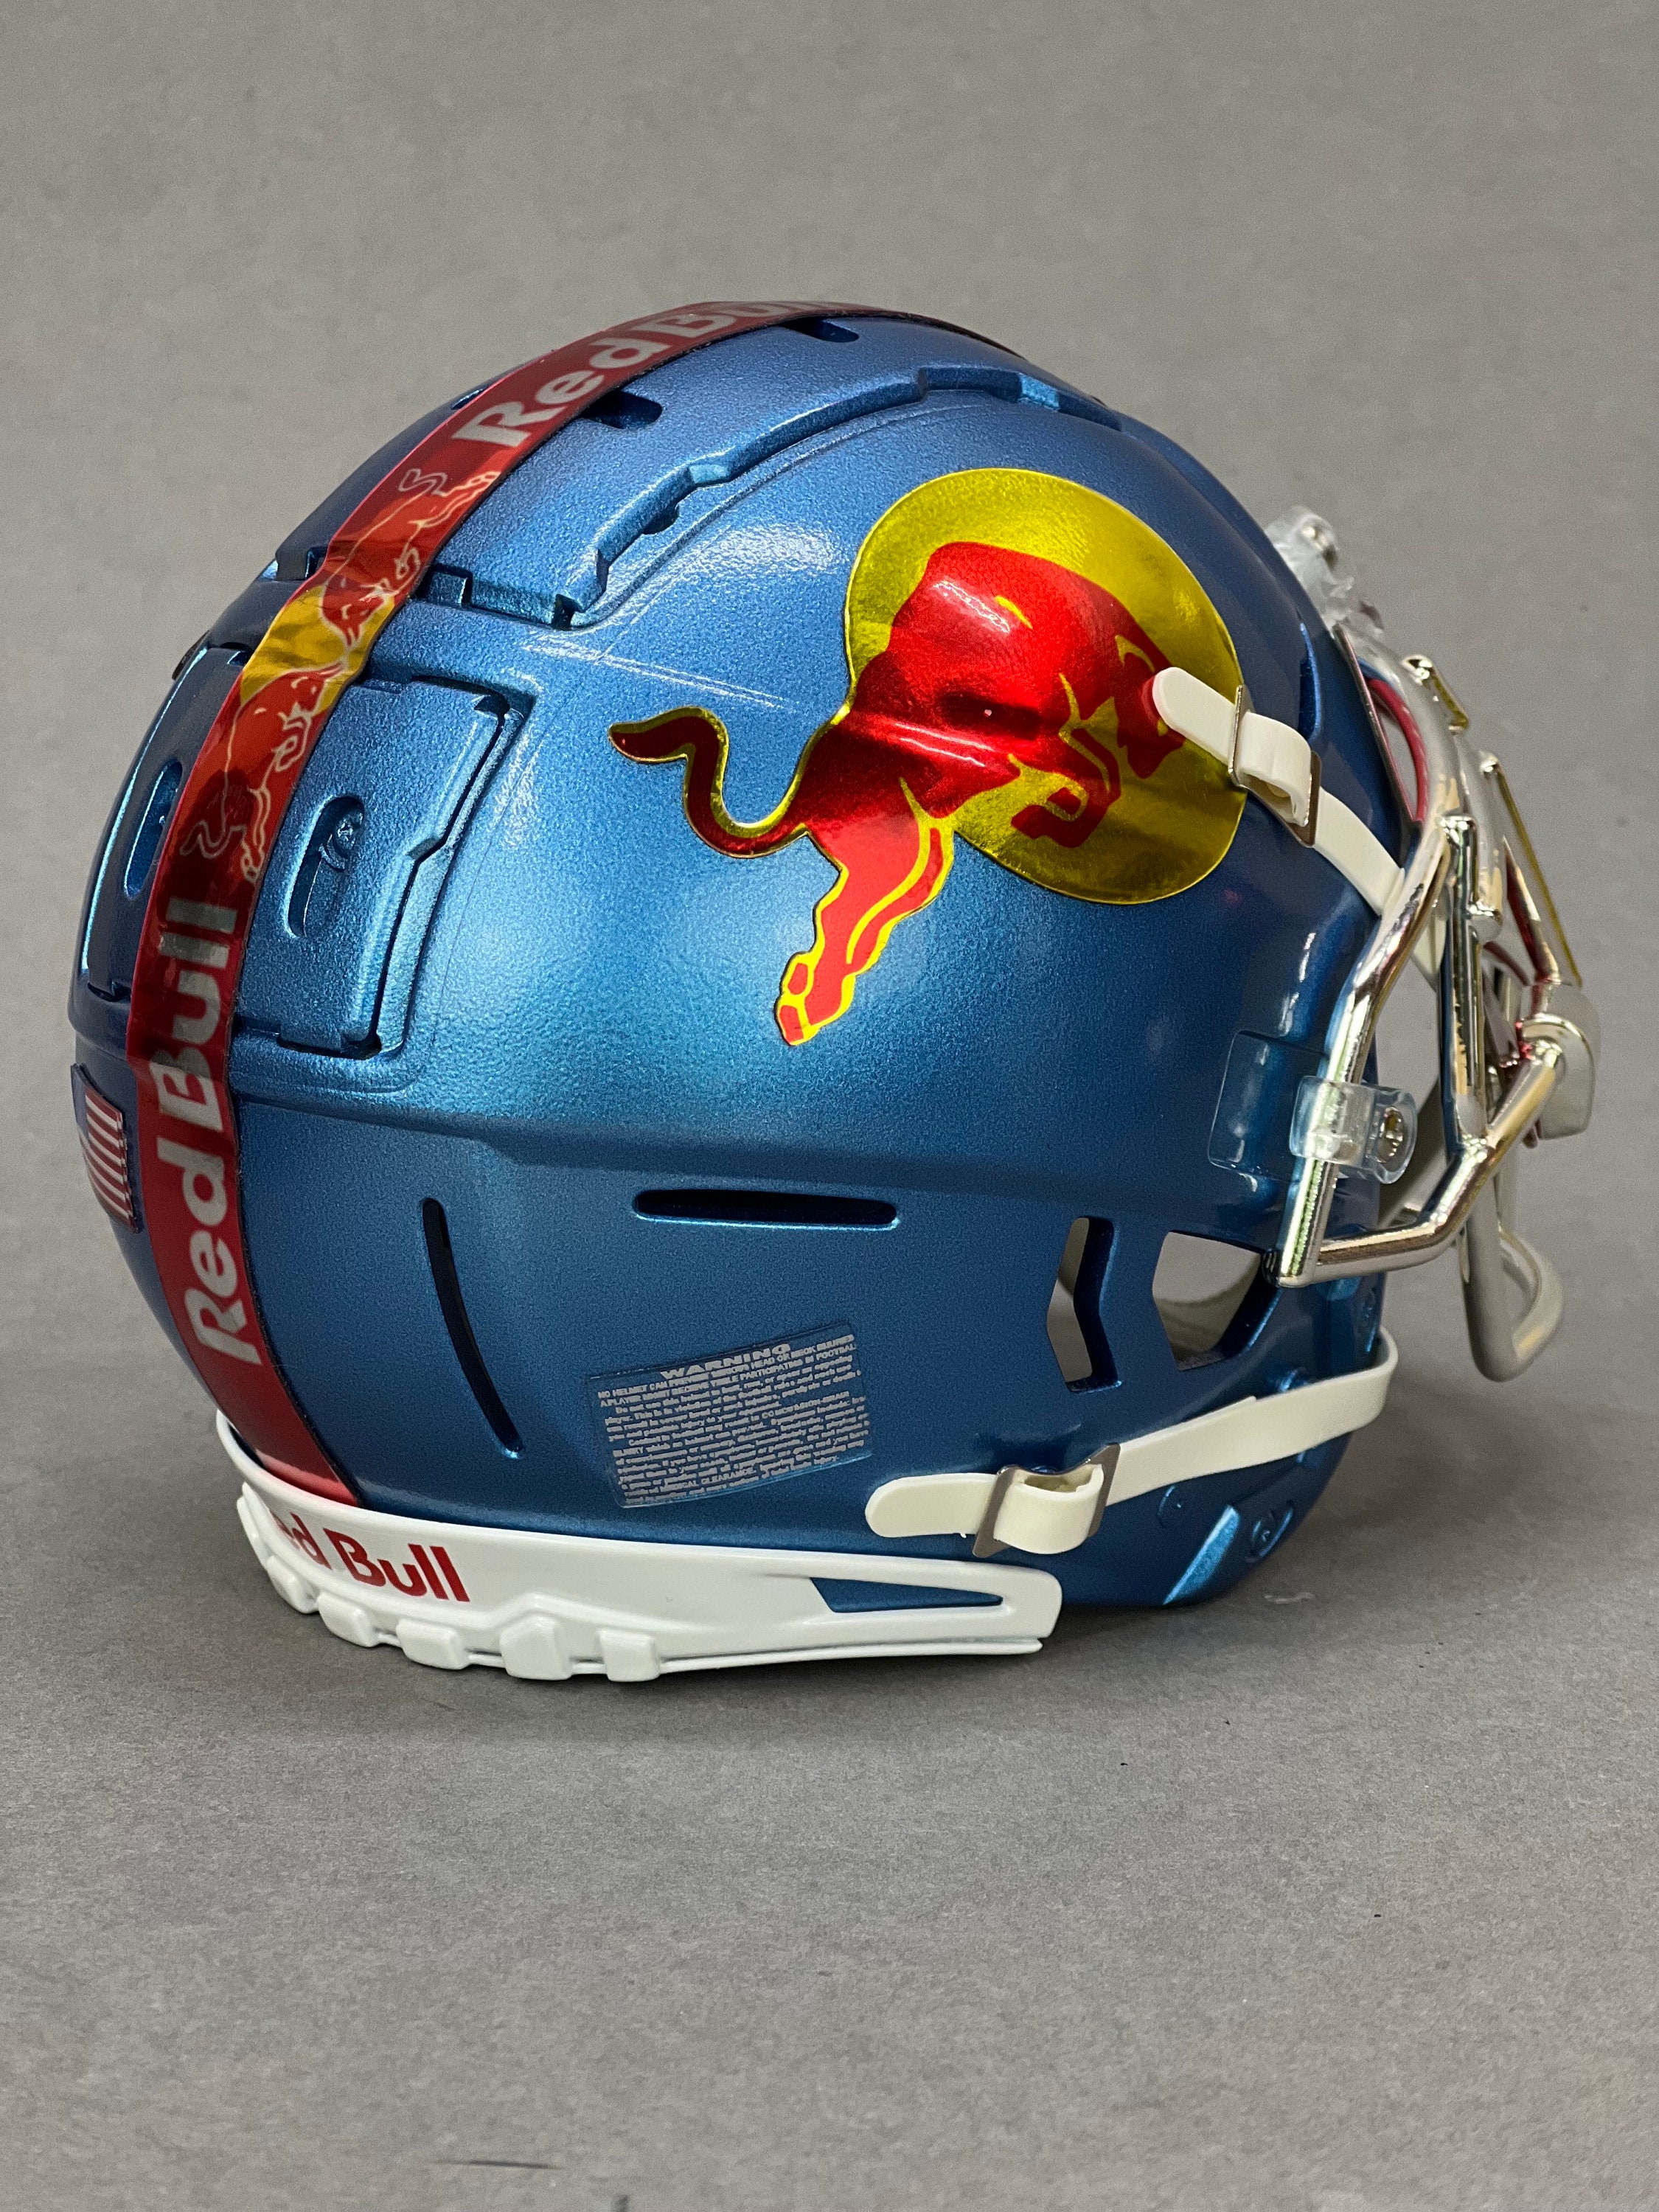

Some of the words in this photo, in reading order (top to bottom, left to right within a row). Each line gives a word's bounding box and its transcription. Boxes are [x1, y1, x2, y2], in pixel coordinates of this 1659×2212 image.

[451, 335, 672, 447] Red
[150, 898, 237, 1132] Bull
[156, 1138, 261, 1365] Red
[660, 1343, 790, 1380] WARNING
[324, 1528, 470, 1602] Bull
